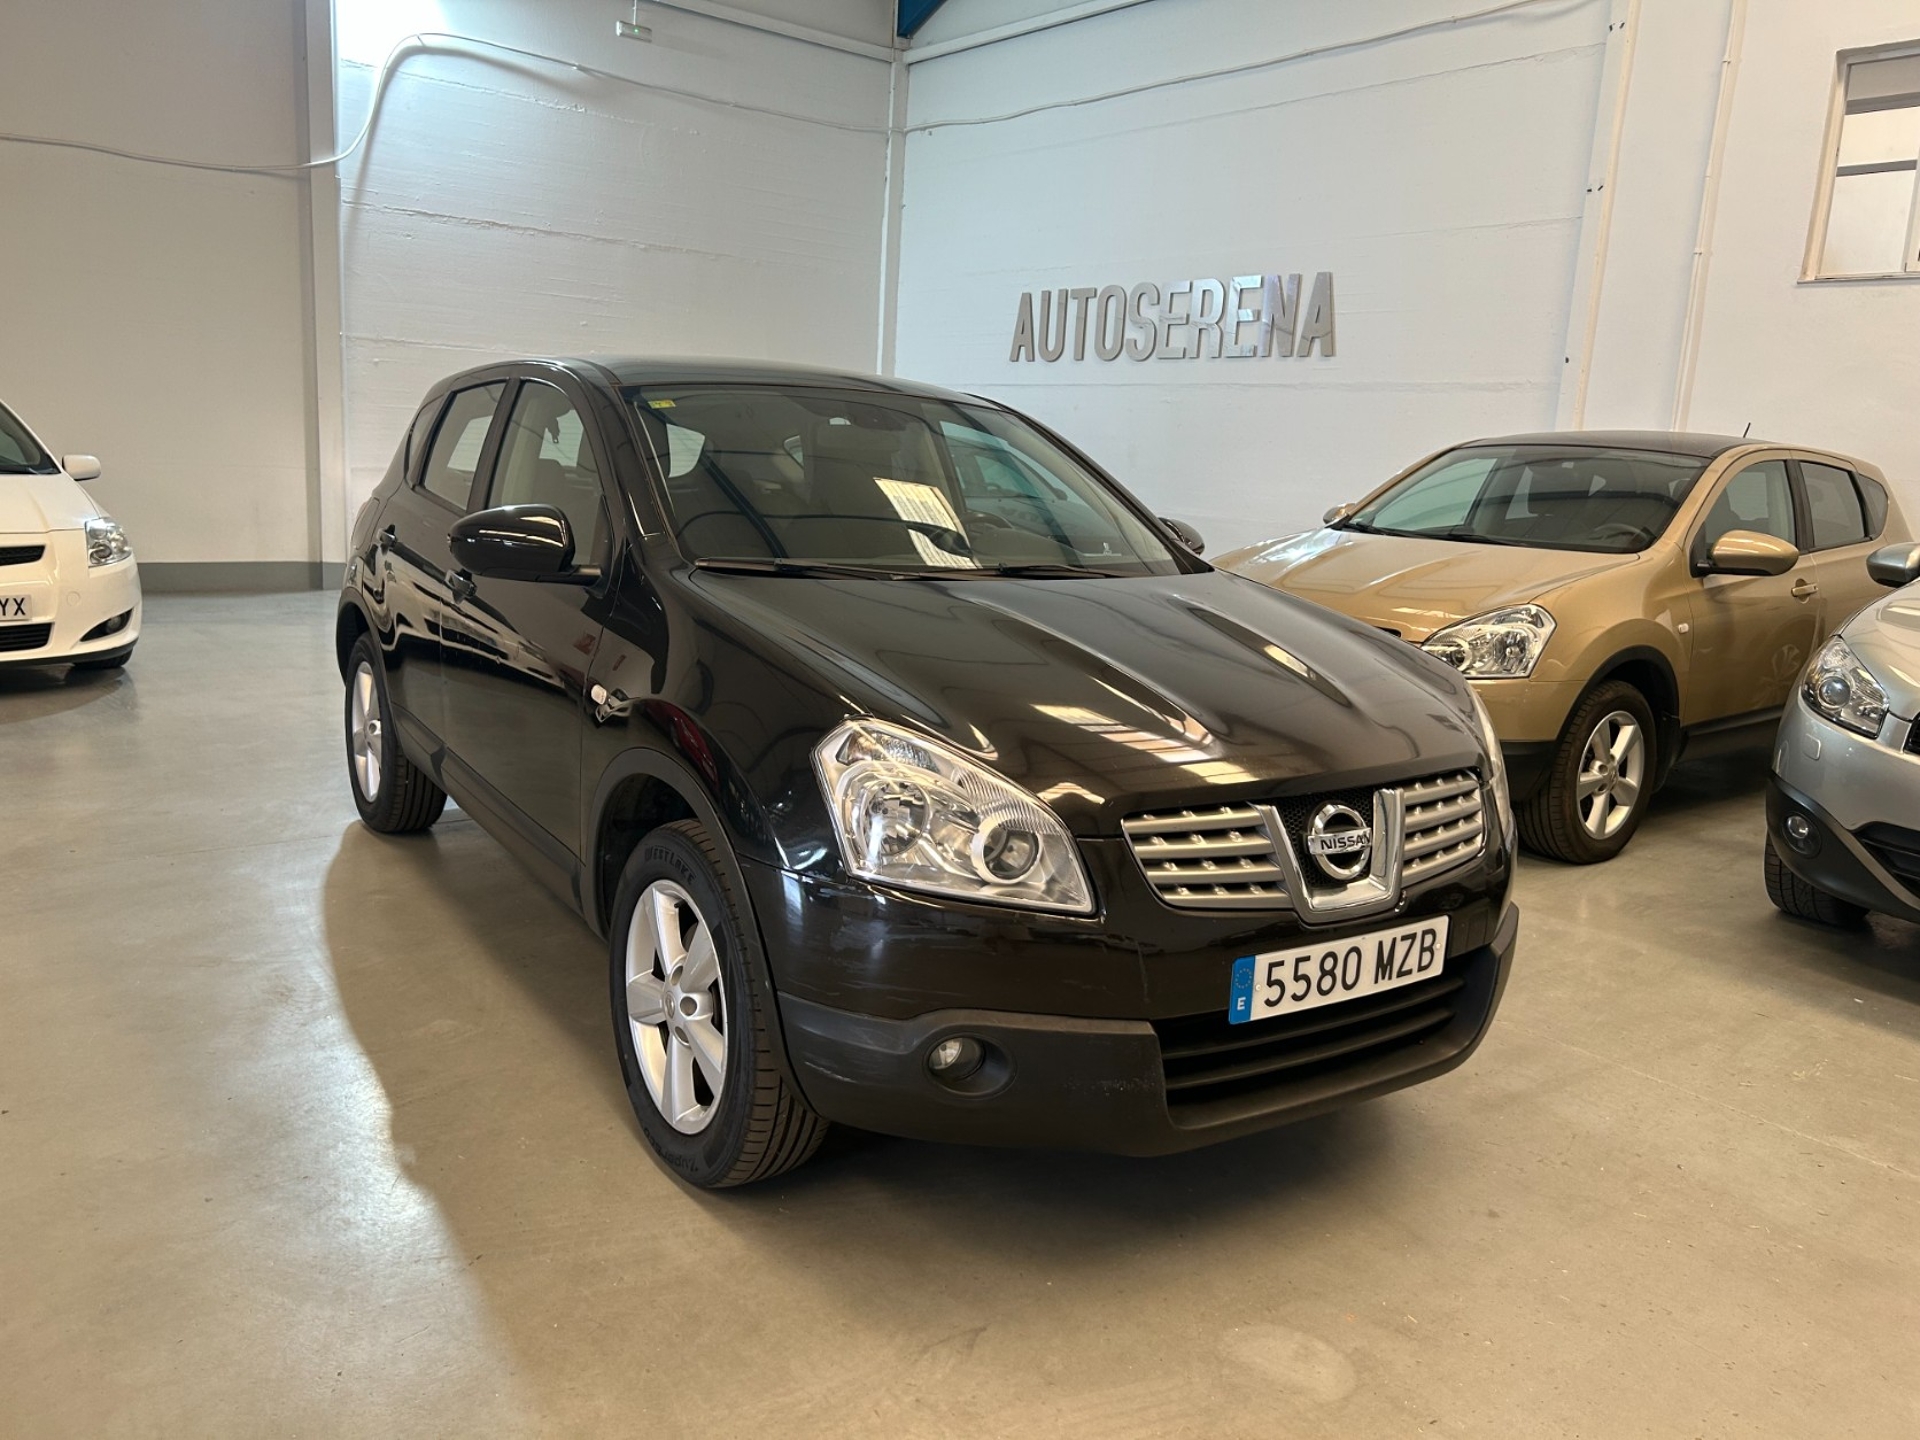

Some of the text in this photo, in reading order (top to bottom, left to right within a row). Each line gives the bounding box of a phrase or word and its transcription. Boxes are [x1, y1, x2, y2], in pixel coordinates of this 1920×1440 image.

[1009, 272, 1336, 362] AUTOSERENA
[1320, 833, 1371, 850] NISSAN
[1237, 928, 1437, 1011] E 5580 MZB
